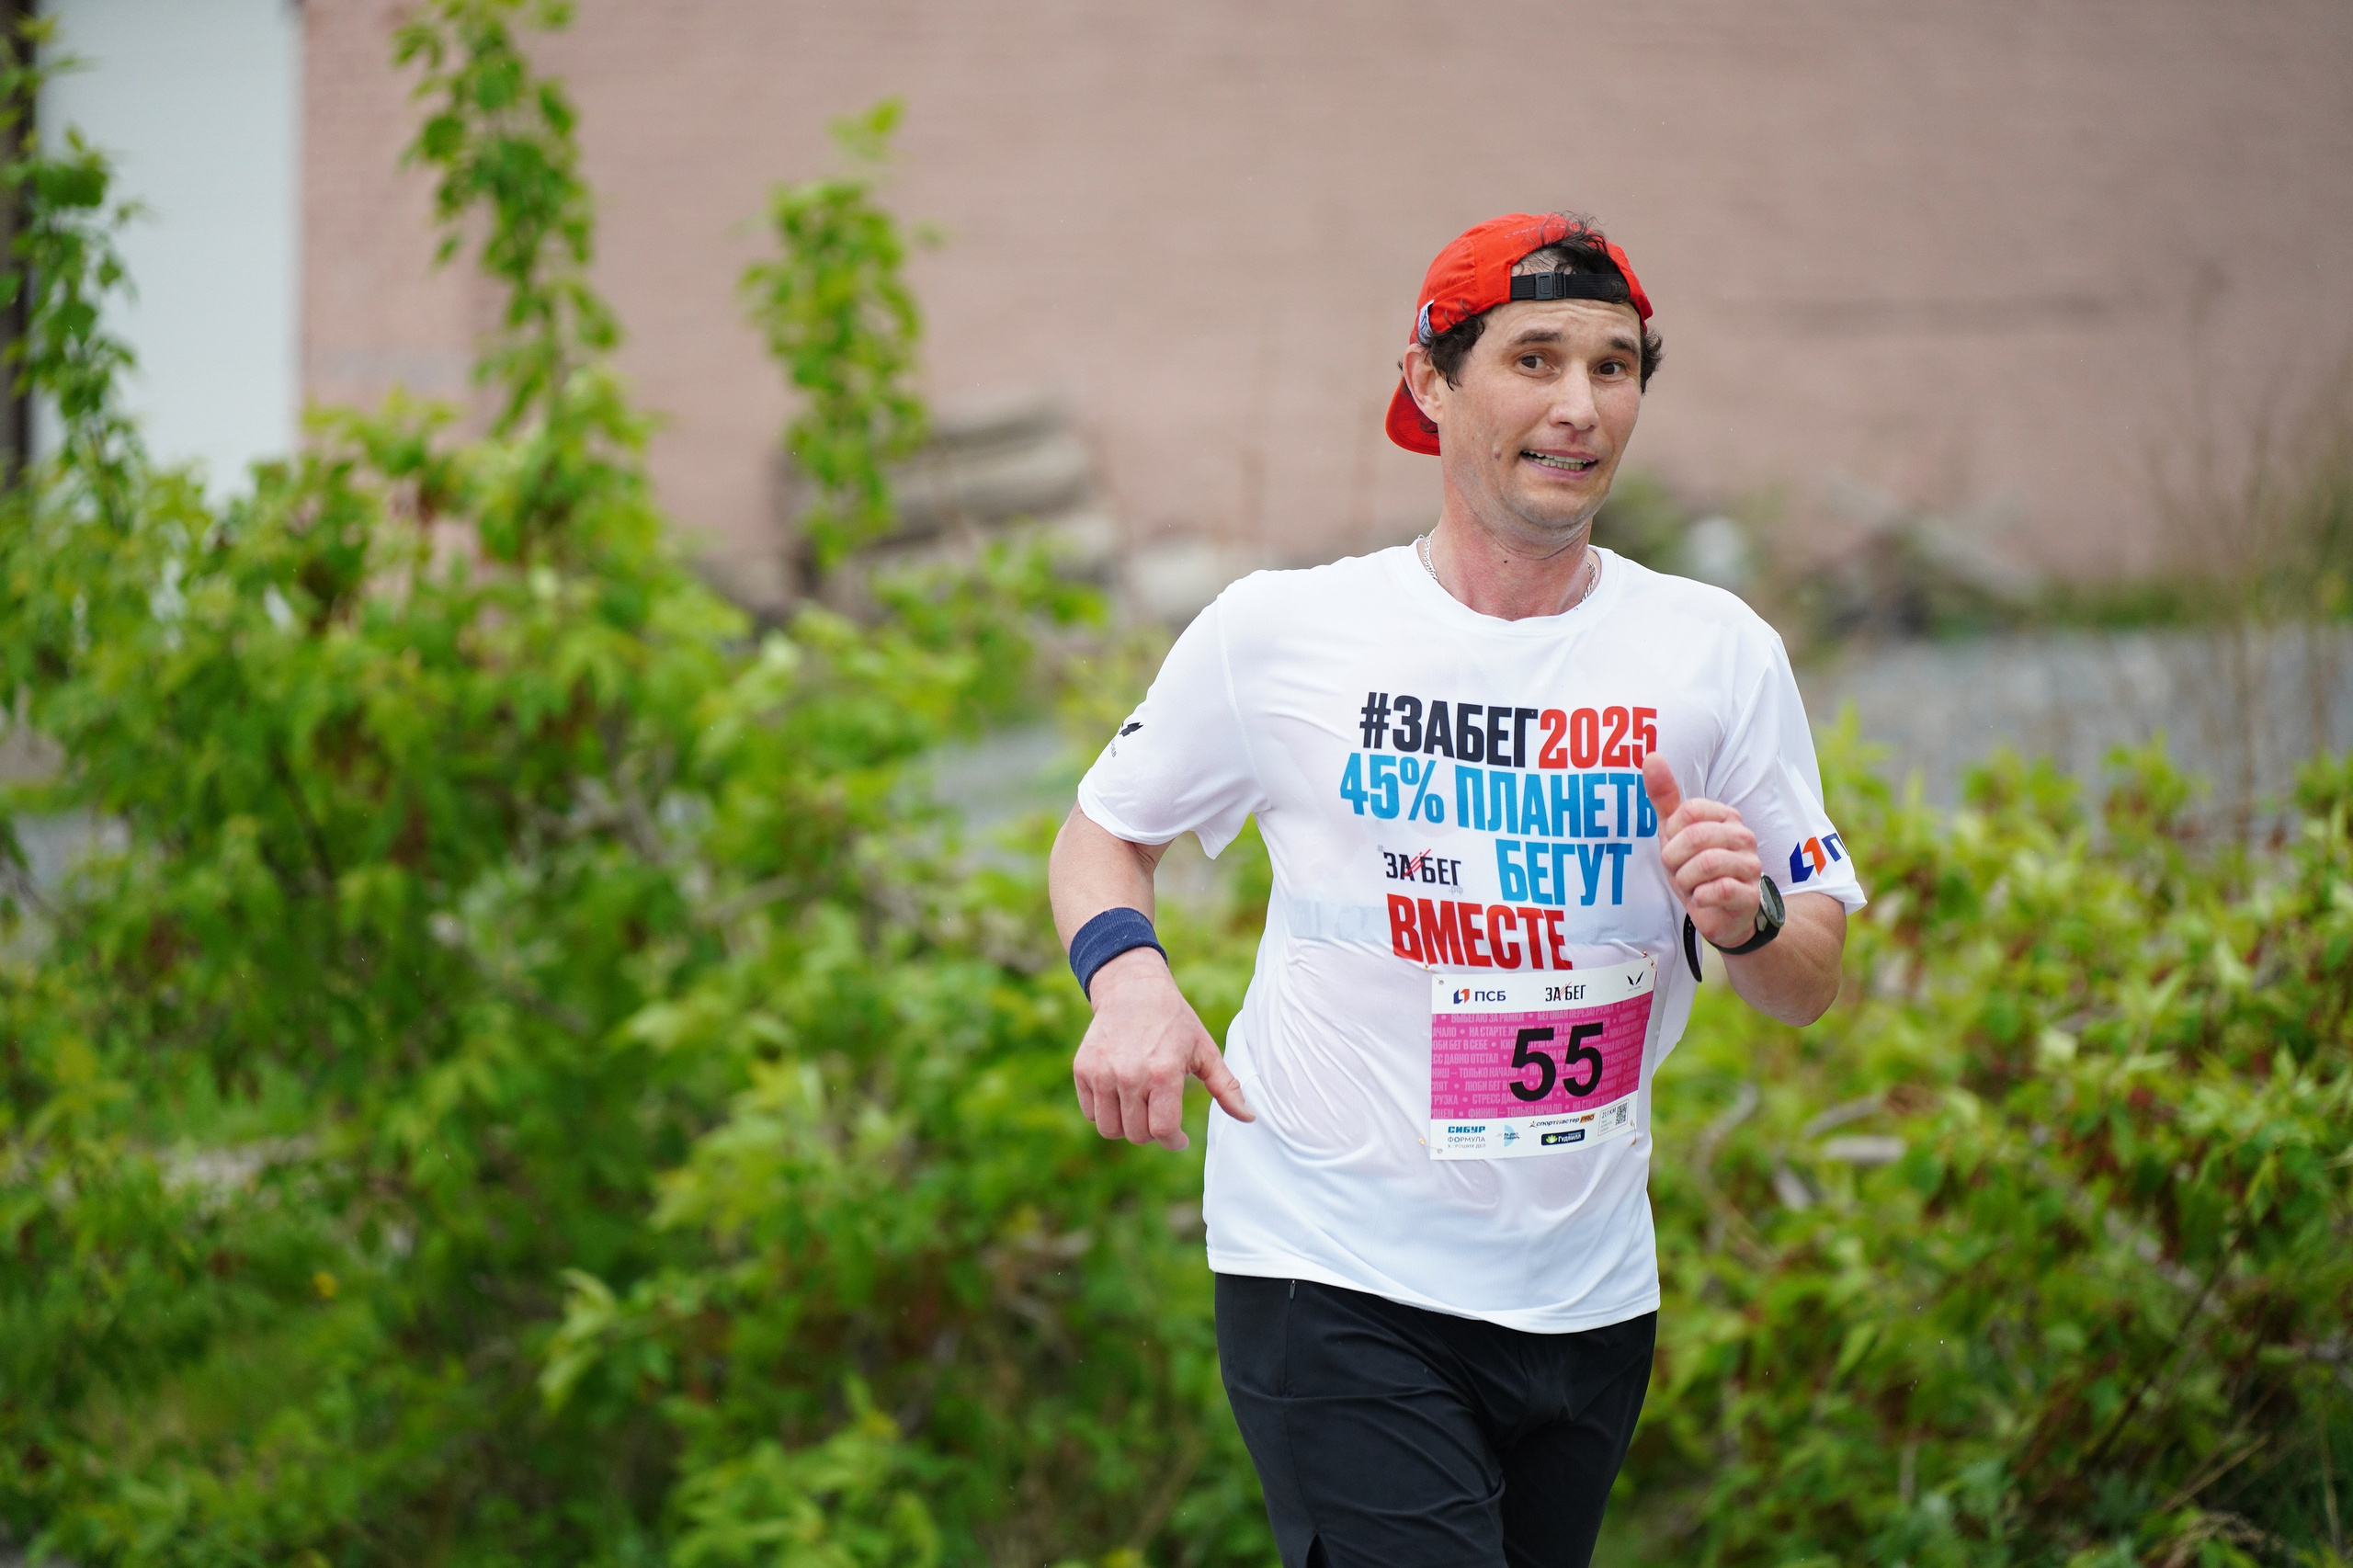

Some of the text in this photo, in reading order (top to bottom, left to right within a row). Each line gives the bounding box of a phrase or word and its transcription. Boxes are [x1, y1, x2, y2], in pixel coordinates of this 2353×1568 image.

[1359, 691, 1657, 769] #ЗАБЕГ2025
[1340, 752, 1445, 824] 45%
[1495, 838, 1632, 906] БЕГУТ
[1387, 893, 1573, 971] ВМЕСТЕ
[1474, 990, 1506, 1002] ПСБ
[1469, 1026, 1479, 1037] НА
[1480, 1026, 1507, 1037] СТАРТЕ
[1463, 1040, 1469, 1050] В
[1470, 1039, 1488, 1050] СЕБЕ
[1444, 1053, 1470, 1065] ДАВНО
[1470, 1053, 1498, 1064] ОТСТАЛ
[1509, 1022, 1603, 1102] 55
[1464, 1080, 1487, 1092] ЛЮБИ
[1489, 1080, 1501, 1091] БЕГ
[1472, 1093, 1500, 1105] СТРЕСС
